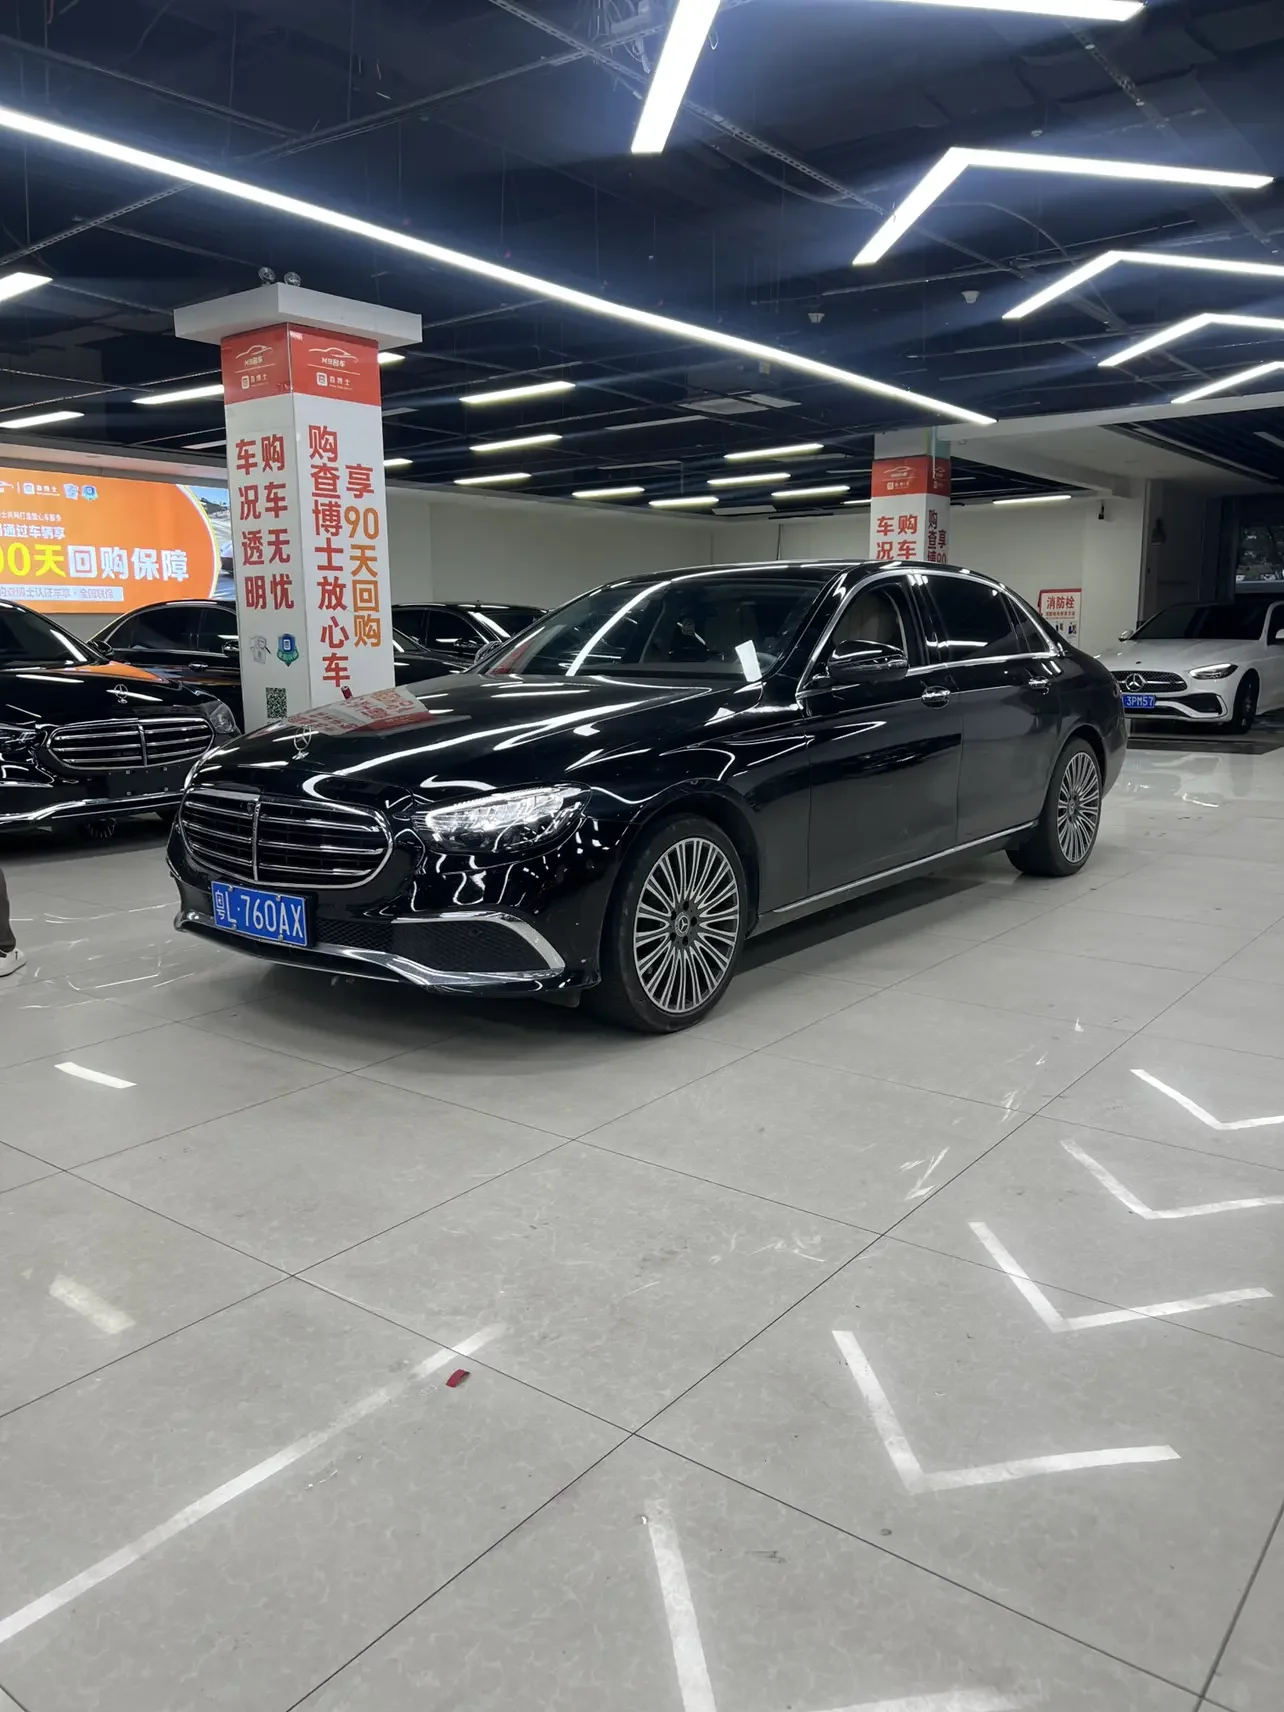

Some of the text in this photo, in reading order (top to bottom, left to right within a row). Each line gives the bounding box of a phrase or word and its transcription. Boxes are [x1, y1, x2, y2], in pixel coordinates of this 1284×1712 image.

[0, 542, 189, 582] 0天回购保障
[236, 438, 267, 610] 车况透明
[261, 434, 294, 610] 购车无忧
[308, 425, 350, 688] 购查博士放心车
[344, 463, 381, 648] 享90天回购
[897, 514, 918, 560] 购车
